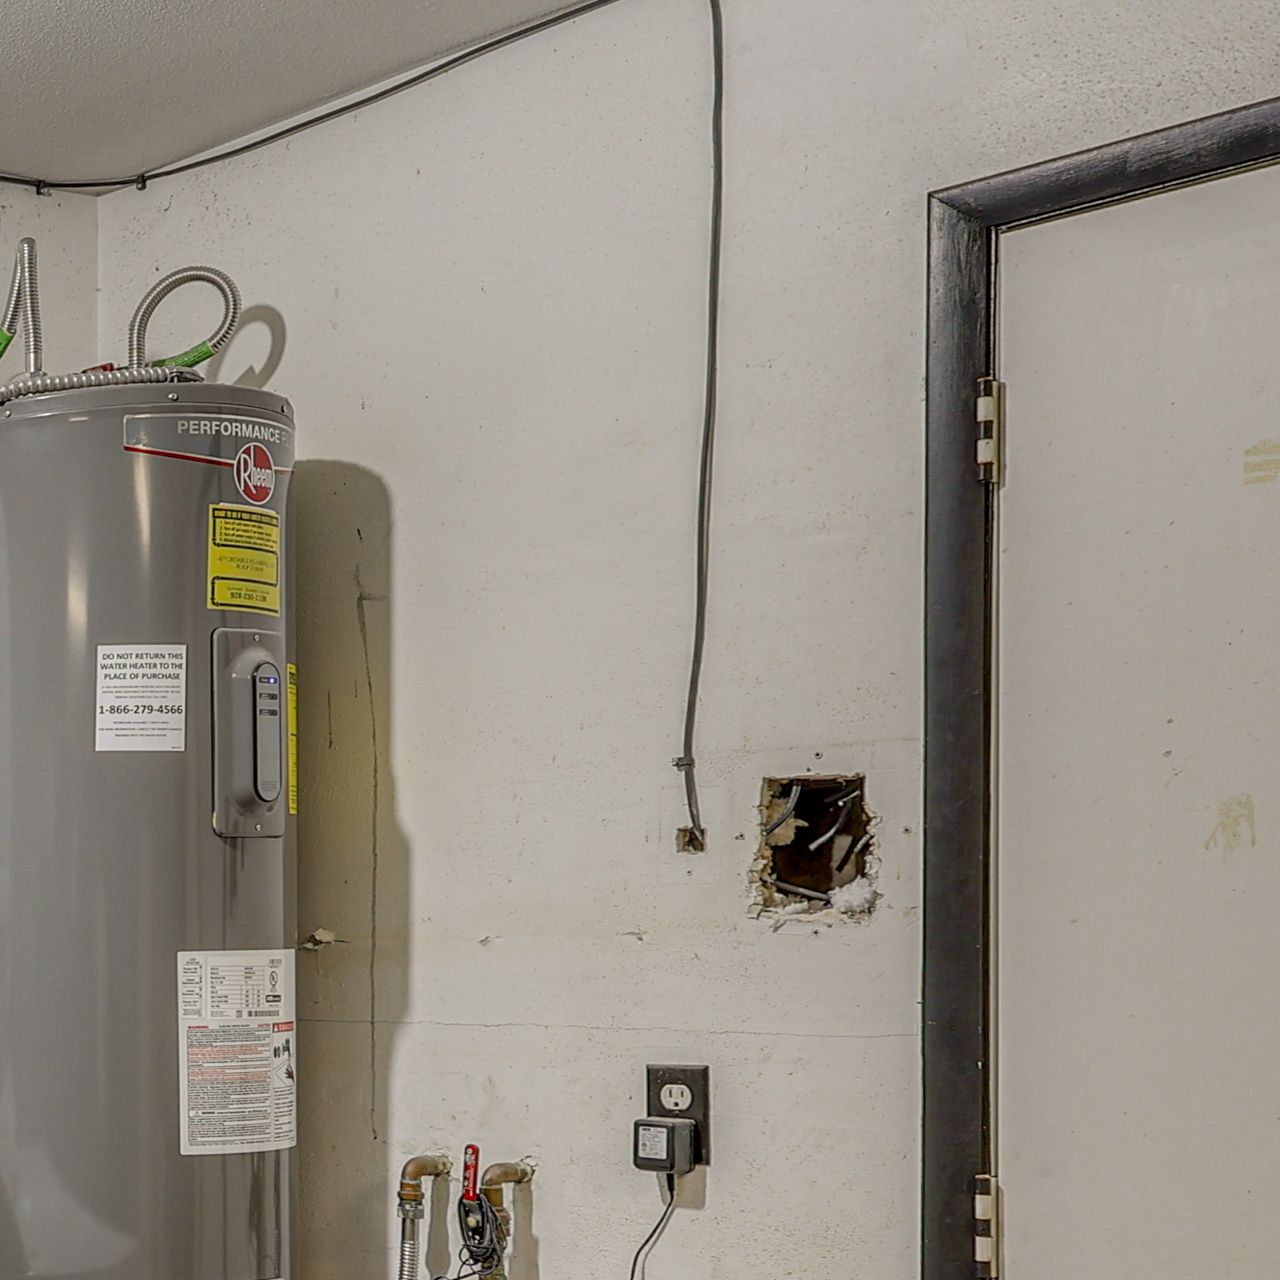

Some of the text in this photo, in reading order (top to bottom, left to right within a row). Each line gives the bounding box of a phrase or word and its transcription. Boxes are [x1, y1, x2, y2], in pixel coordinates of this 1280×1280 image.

[178, 421, 280, 444] PERFORMANCE
[241, 445, 272, 494] Rheem
[99, 705, 183, 714] 1-866-279-4566
